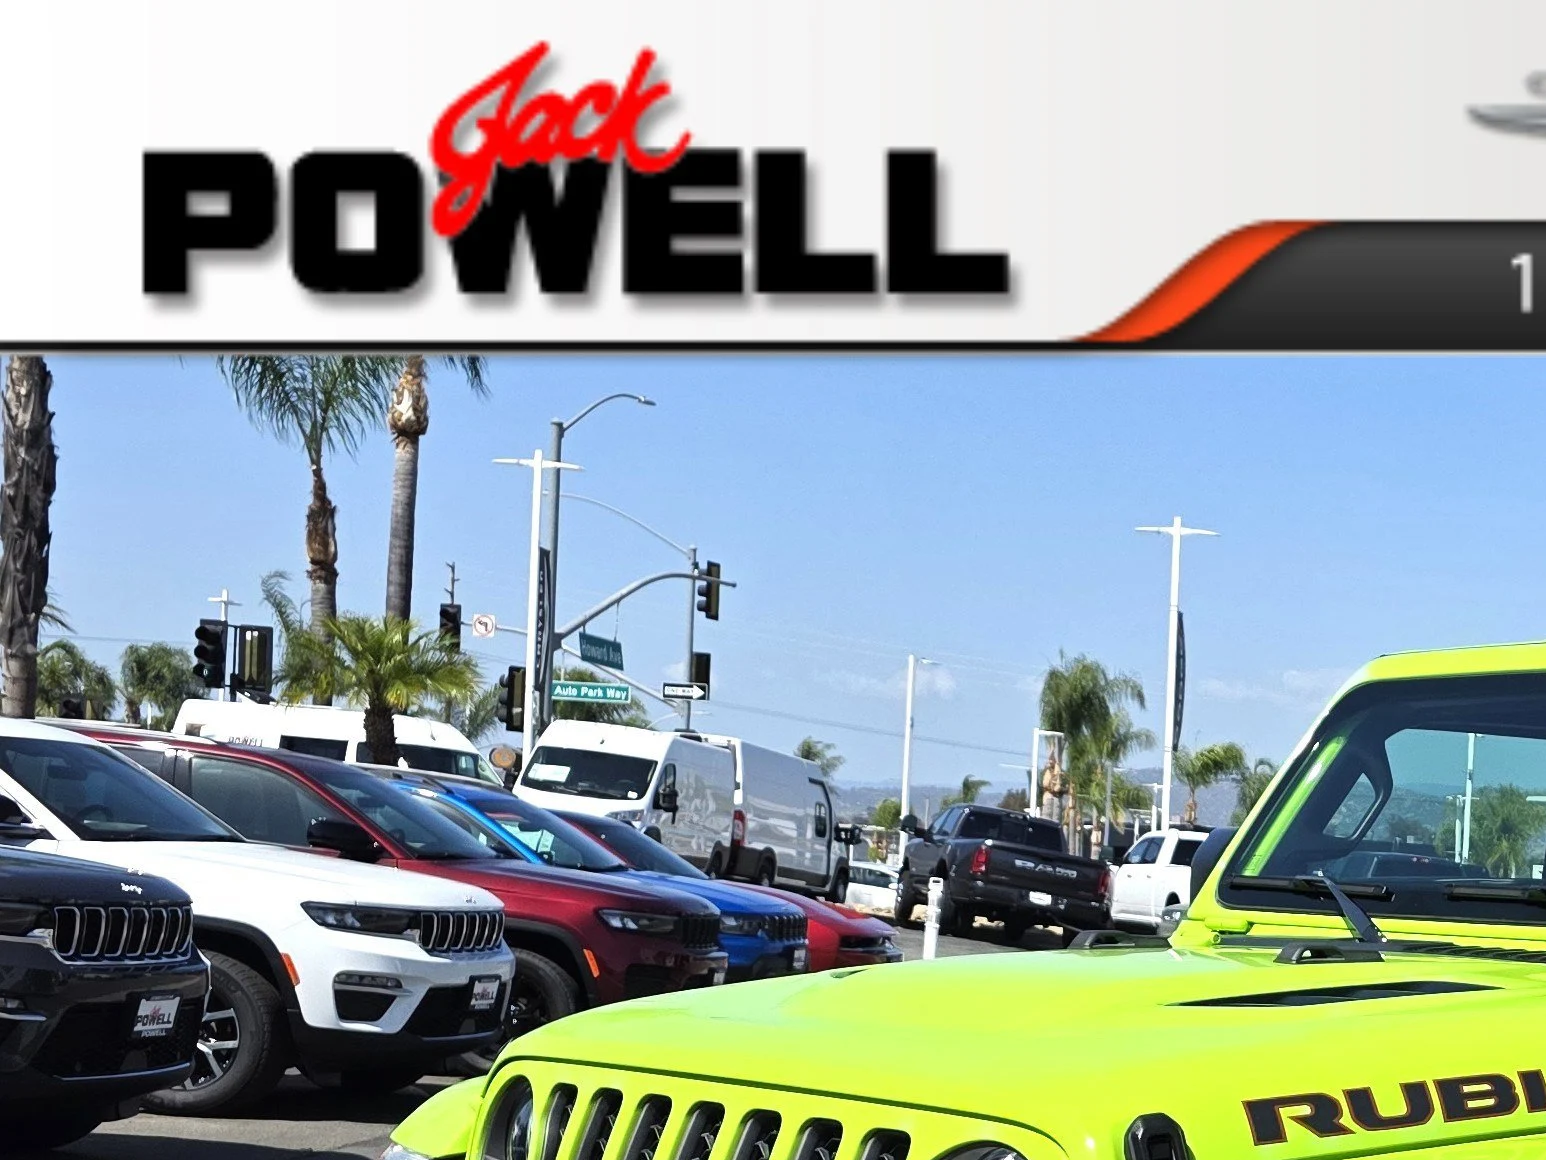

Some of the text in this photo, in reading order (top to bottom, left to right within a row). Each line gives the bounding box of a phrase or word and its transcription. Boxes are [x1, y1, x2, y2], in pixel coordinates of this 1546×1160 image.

[581, 640, 623, 664] Howard Ave
[554, 685, 627, 700] Auto Park Way
[136, 1012, 172, 1027] POWELL
